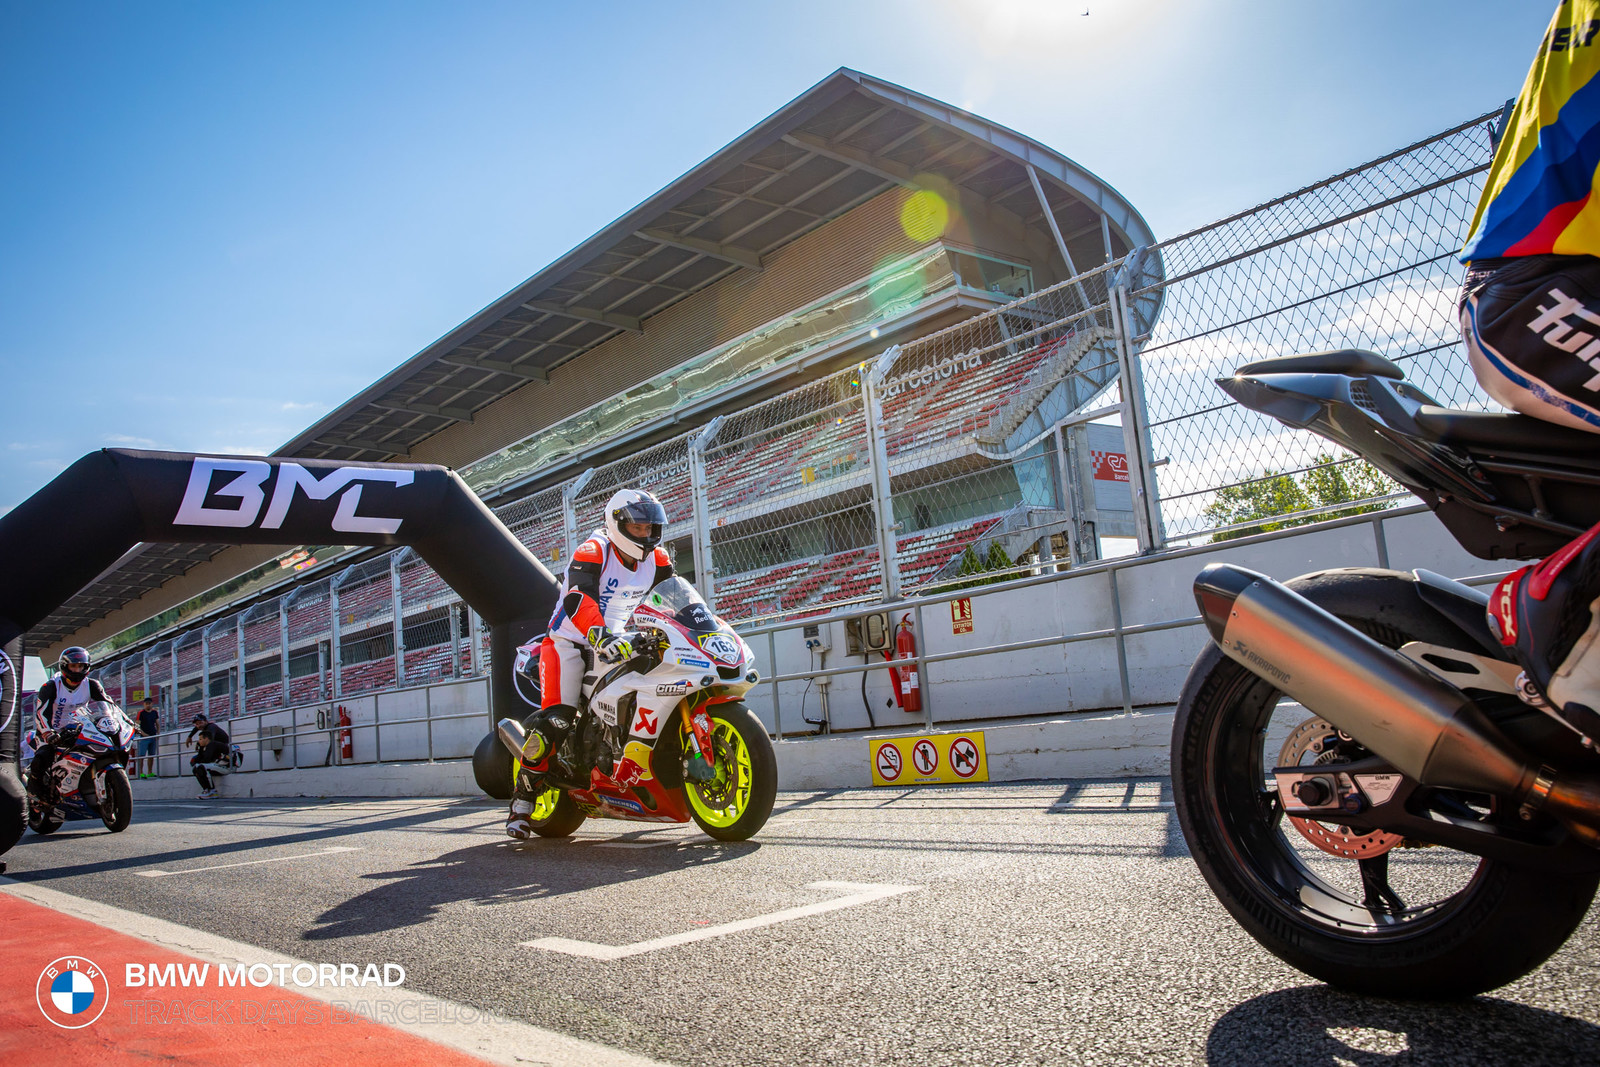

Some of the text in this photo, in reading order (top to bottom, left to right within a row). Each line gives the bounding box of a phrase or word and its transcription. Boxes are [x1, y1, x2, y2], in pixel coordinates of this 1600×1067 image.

[639, 452, 689, 487] Barcelo
[172, 456, 415, 534] BMC
[1501, 580, 1516, 637] TCX
[711, 640, 736, 653] 163
